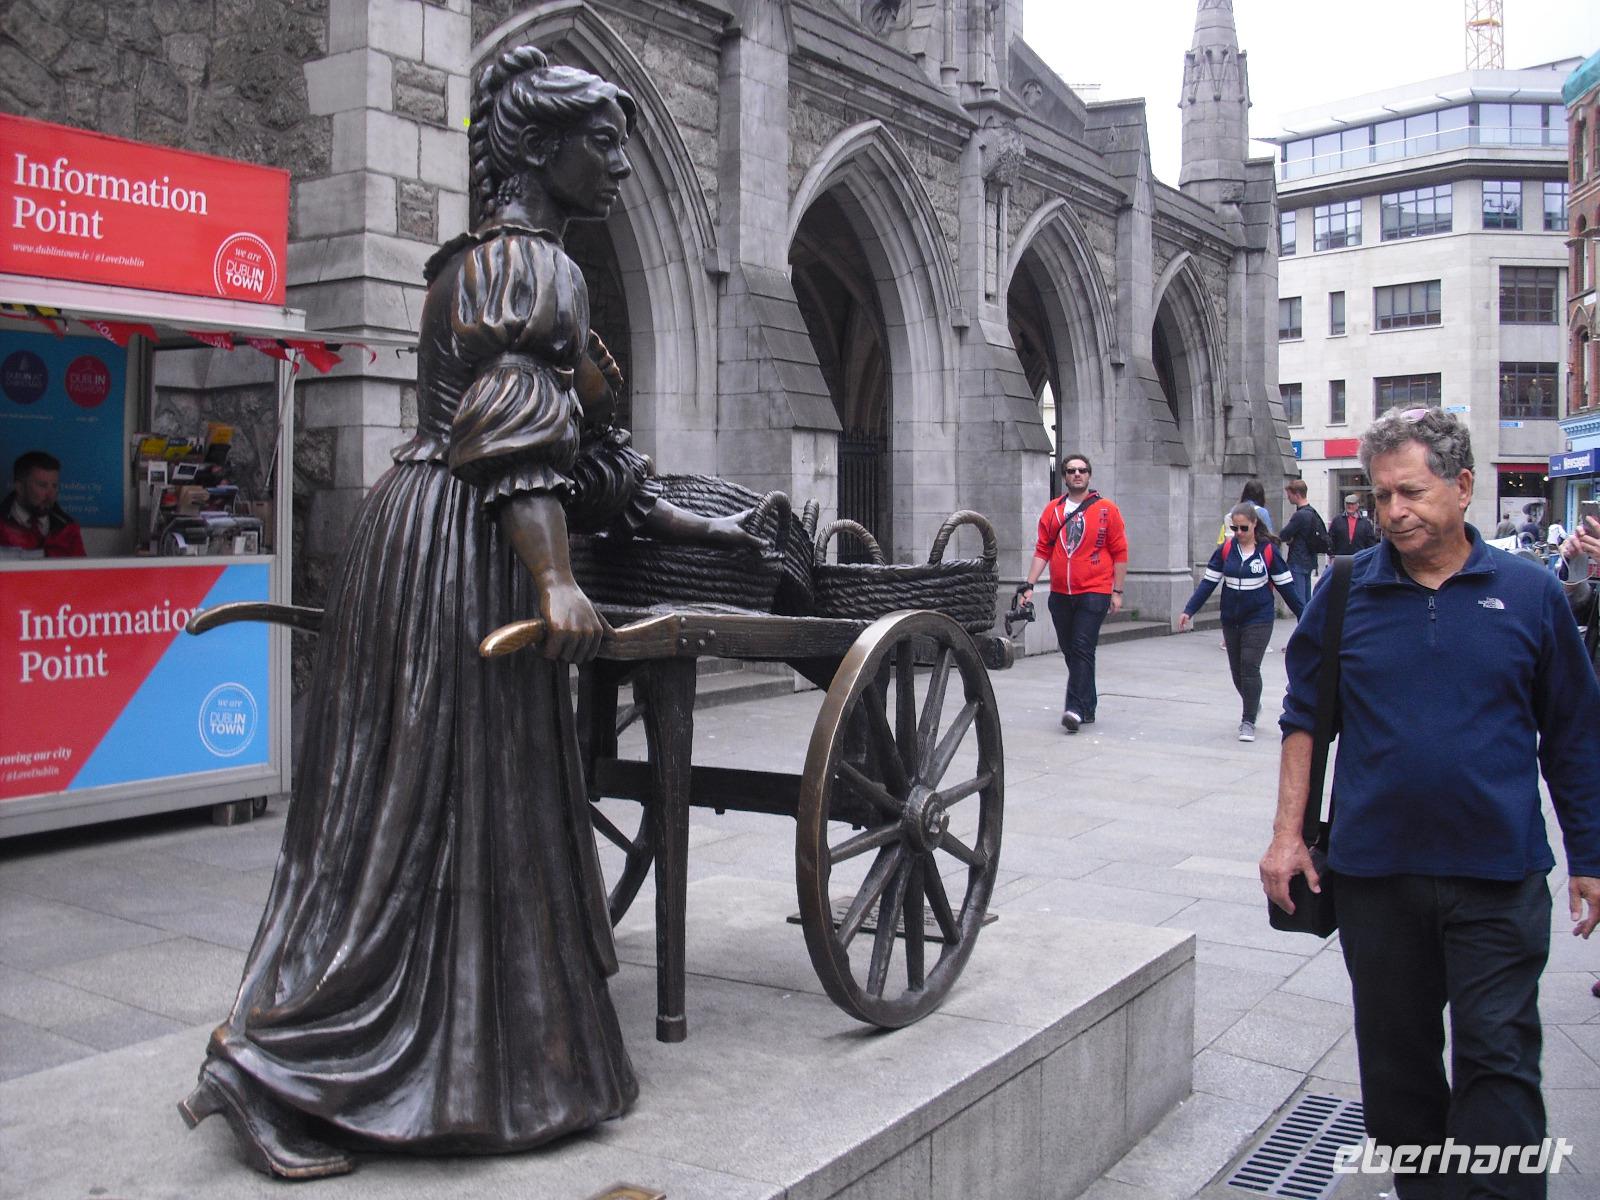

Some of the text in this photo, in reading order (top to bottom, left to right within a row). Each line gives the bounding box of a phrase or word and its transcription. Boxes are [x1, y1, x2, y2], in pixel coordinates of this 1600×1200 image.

[14, 153, 208, 216] Information
[12, 196, 104, 240] Point
[12, 242, 89, 260] www.dublintown.ie
[235, 247, 262, 262] we are
[226, 259, 265, 281] DUBLIN
[225, 270, 264, 293] TOWN
[19, 645, 109, 683] Point
[209, 711, 246, 725] DUBLIN
[210, 722, 245, 735] TOWN
[33, 750, 51, 761] our
[52, 746, 72, 761] city
